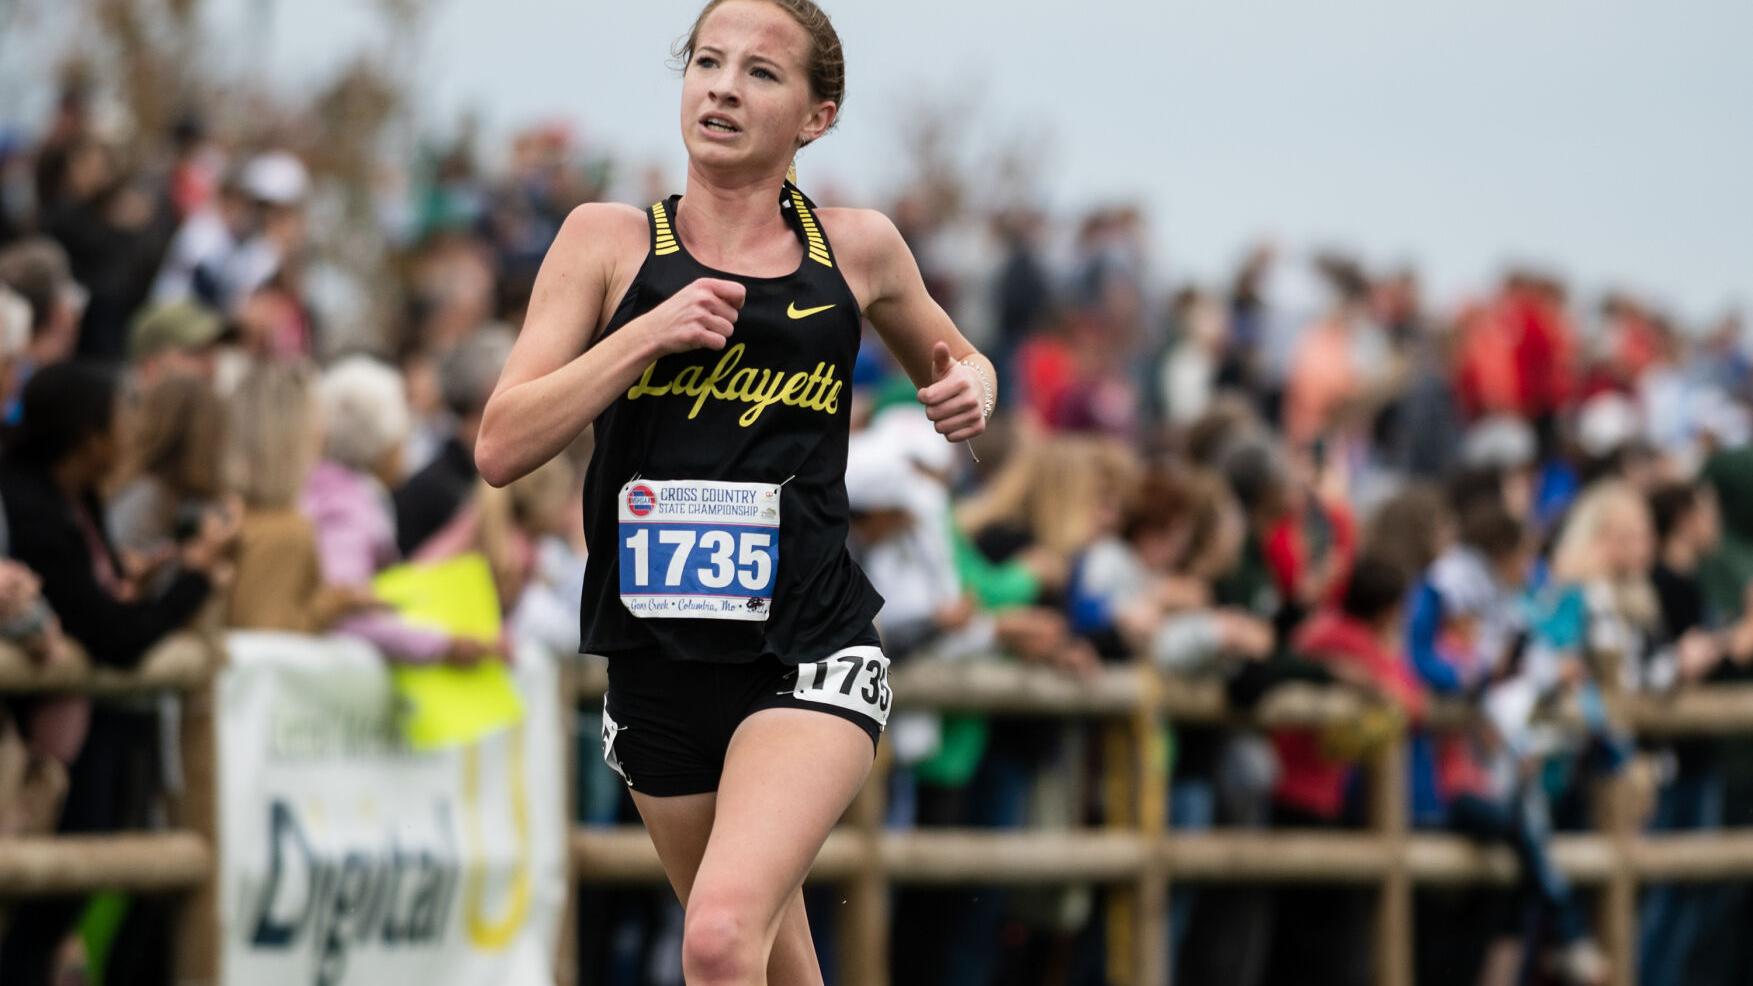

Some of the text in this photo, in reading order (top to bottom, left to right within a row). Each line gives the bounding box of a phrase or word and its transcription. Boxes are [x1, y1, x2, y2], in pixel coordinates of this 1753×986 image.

[628, 343, 843, 427] Lafayette
[658, 503, 686, 514] STATE
[688, 503, 759, 517] CHAMPIONSHIP
[660, 487, 698, 502] CROSS
[701, 488, 757, 504] COUNTRY
[626, 528, 772, 590] 1735
[812, 655, 890, 711] 1735
